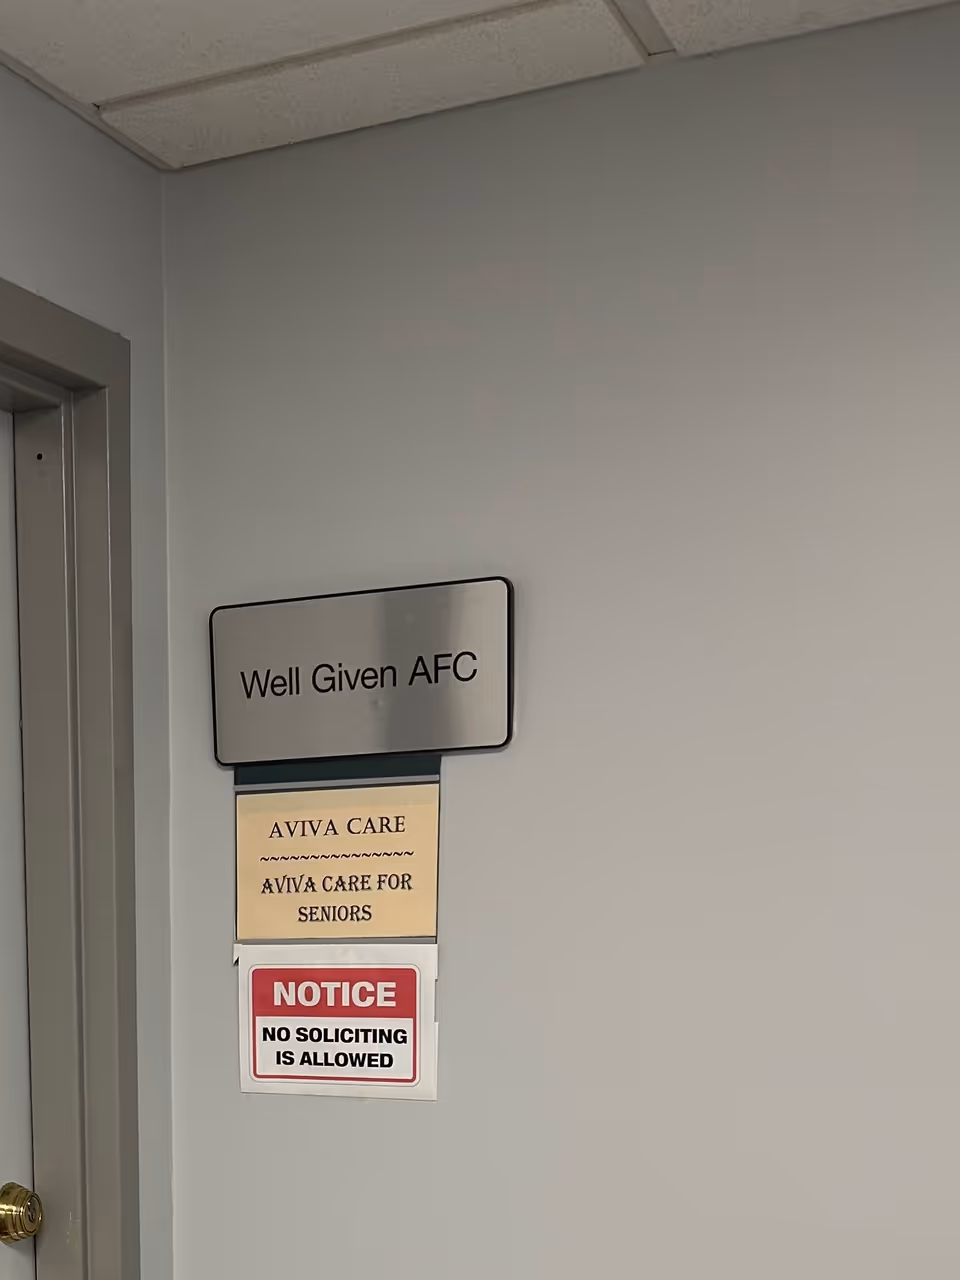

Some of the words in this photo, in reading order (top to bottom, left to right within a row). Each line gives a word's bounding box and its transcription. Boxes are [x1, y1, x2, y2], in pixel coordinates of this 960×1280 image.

[240, 666, 300, 699] Well
[311, 663, 397, 694] Given
[408, 651, 478, 687] AFC
[268, 818, 339, 839] AVIVA
[346, 815, 406, 835] CARE
[261, 874, 317, 894] AVIVA
[322, 874, 372, 892] CARE
[376, 873, 413, 891] FOR
[297, 904, 372, 922] SENIORS
[273, 981, 397, 1007] NOTICE
[262, 1027, 291, 1042] NO
[295, 1027, 408, 1044] SOLICITING
[276, 1051, 295, 1065] IS
[299, 1052, 394, 1068] ALLOWED
